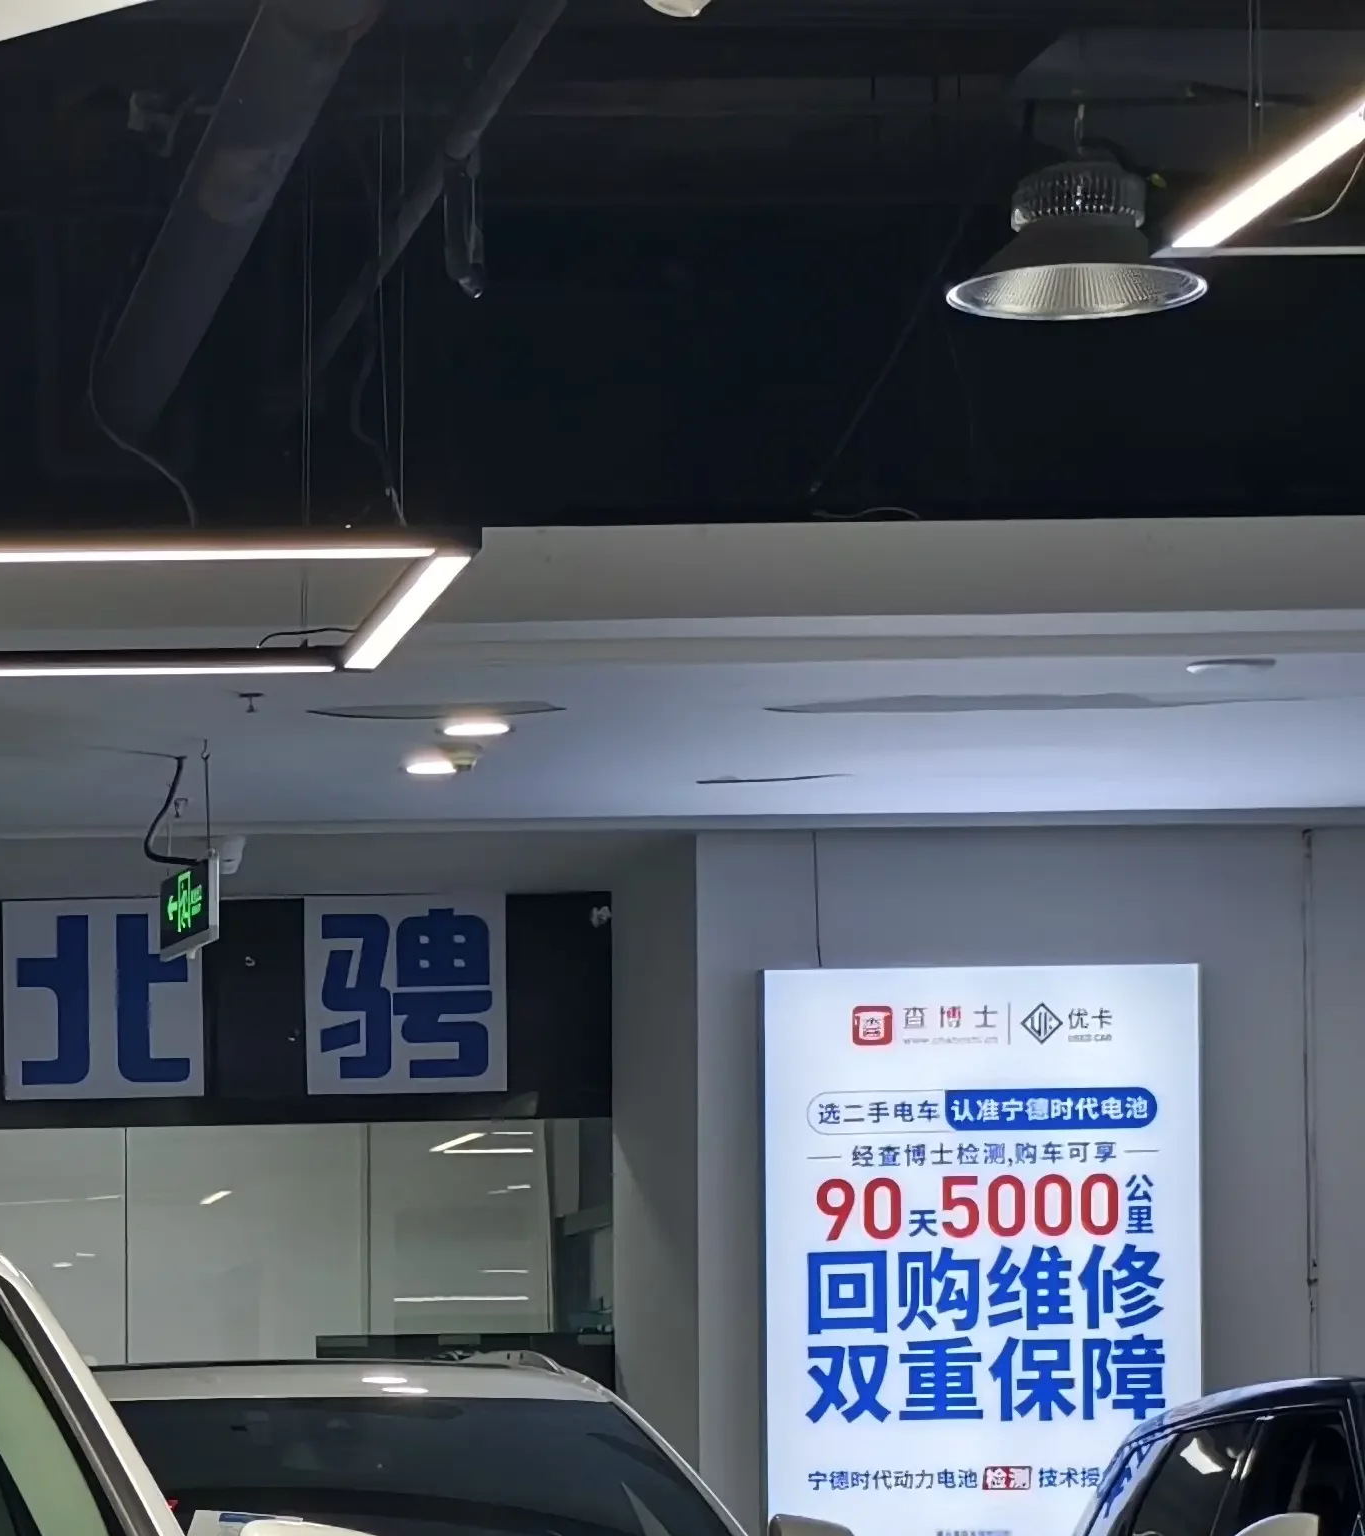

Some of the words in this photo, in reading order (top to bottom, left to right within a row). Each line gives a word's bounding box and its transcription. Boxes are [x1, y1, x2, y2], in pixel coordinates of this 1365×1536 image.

[903, 1005, 998, 1029] 查博士
[1068, 1008, 1112, 1029] 优卡
[818, 1100, 940, 1124] 选二手电车
[951, 1096, 1148, 1122] 认准宁德时代电池
[807, 1244, 1165, 1335] 回购维修
[806, 1335, 1166, 1423] 双重保障
[808, 1469, 978, 1490] 宁德时代动力电池
[985, 1468, 1030, 1489] 检测
